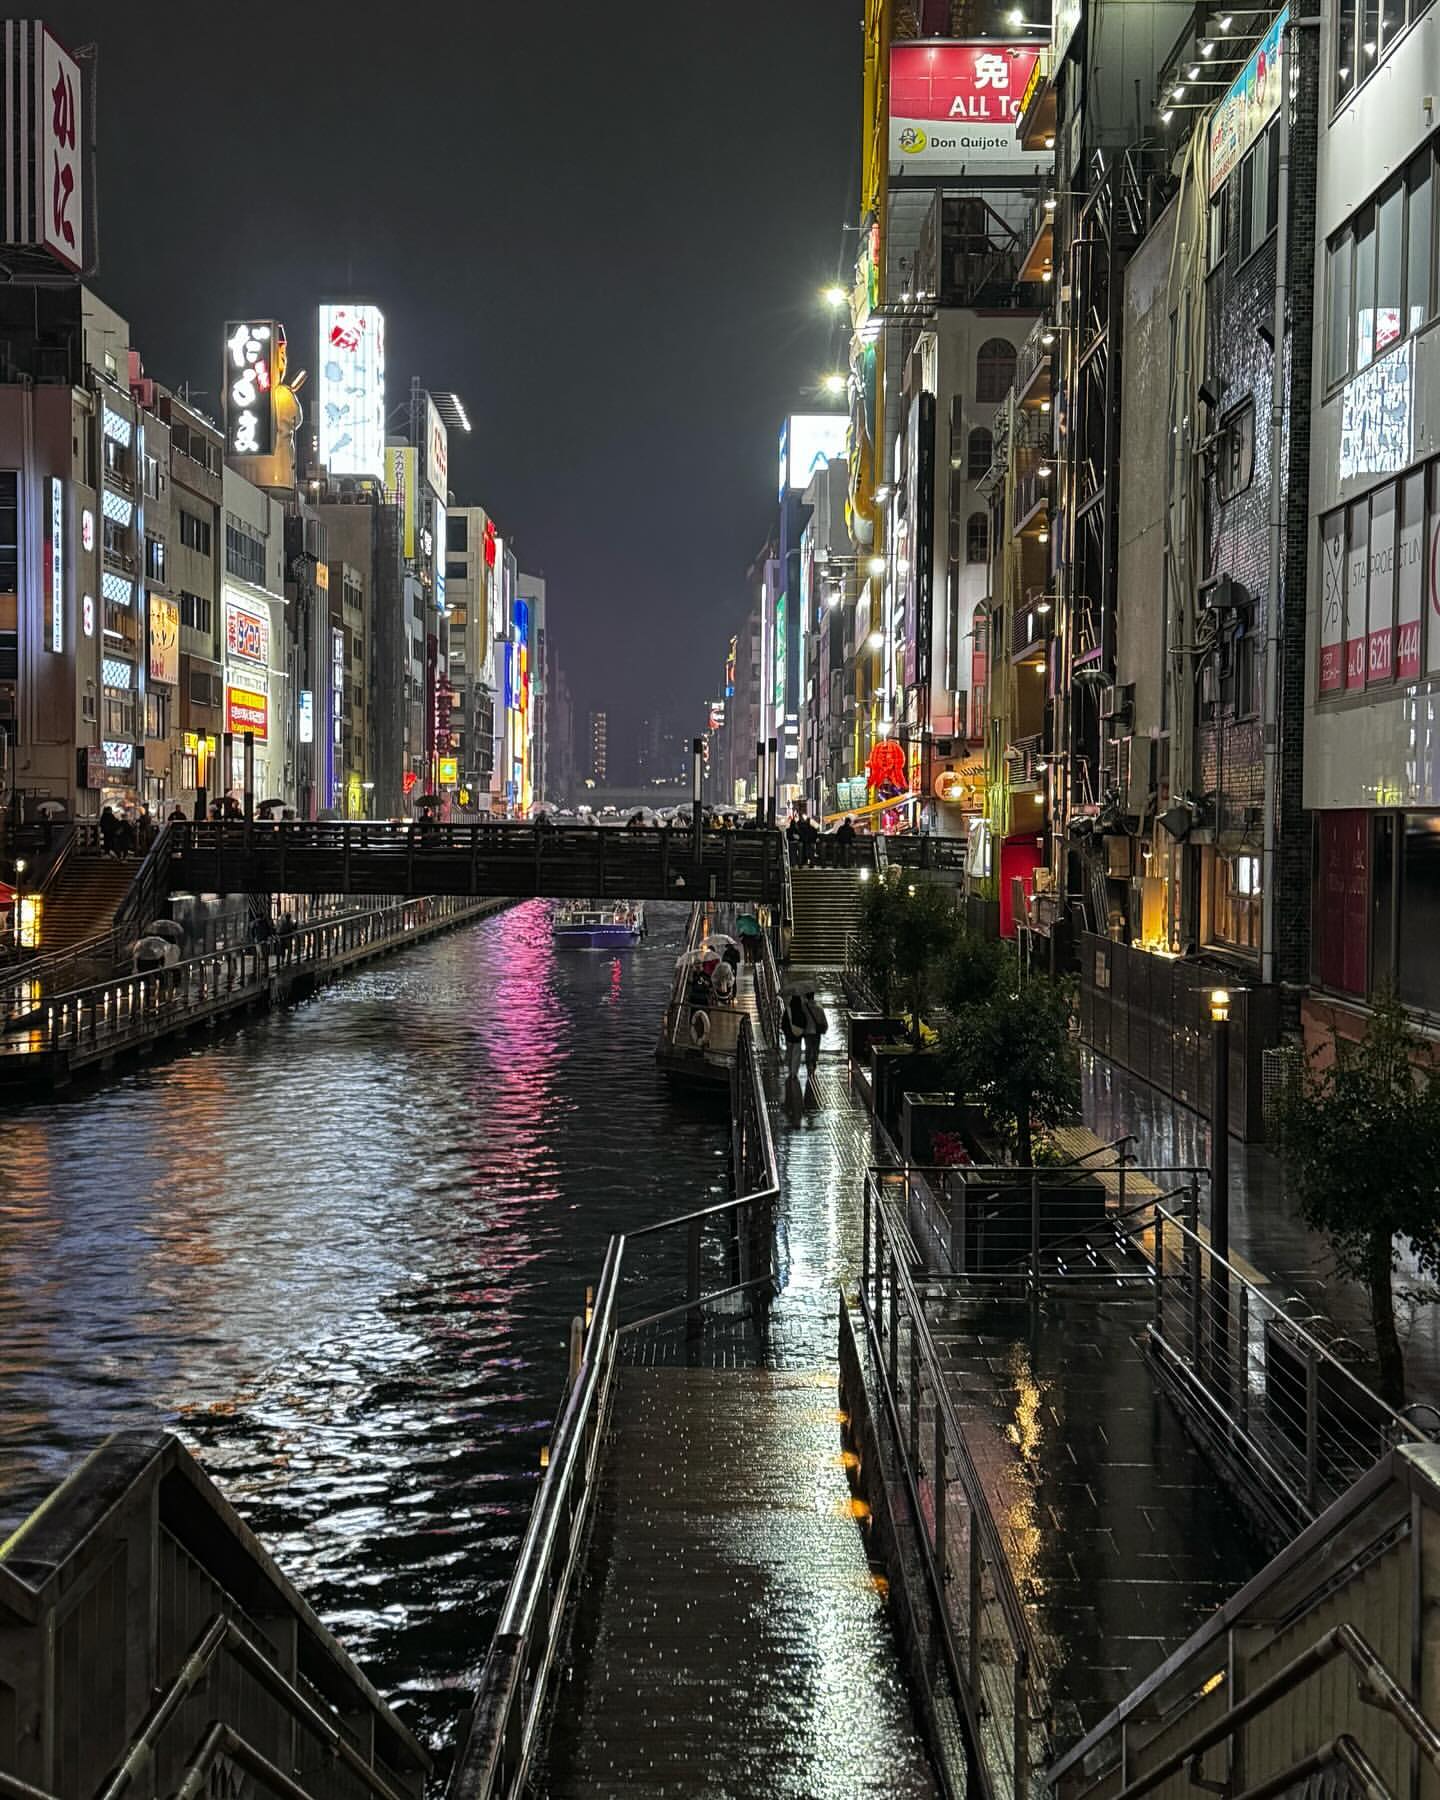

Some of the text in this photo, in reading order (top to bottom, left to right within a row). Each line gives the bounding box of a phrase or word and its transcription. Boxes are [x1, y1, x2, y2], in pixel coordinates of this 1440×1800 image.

[974, 54, 1009, 88] 免
[949, 96, 990, 116] ALL
[52, 60, 75, 249] かに
[931, 137, 1009, 149] Don Quijote
[228, 324, 270, 452] だるま
